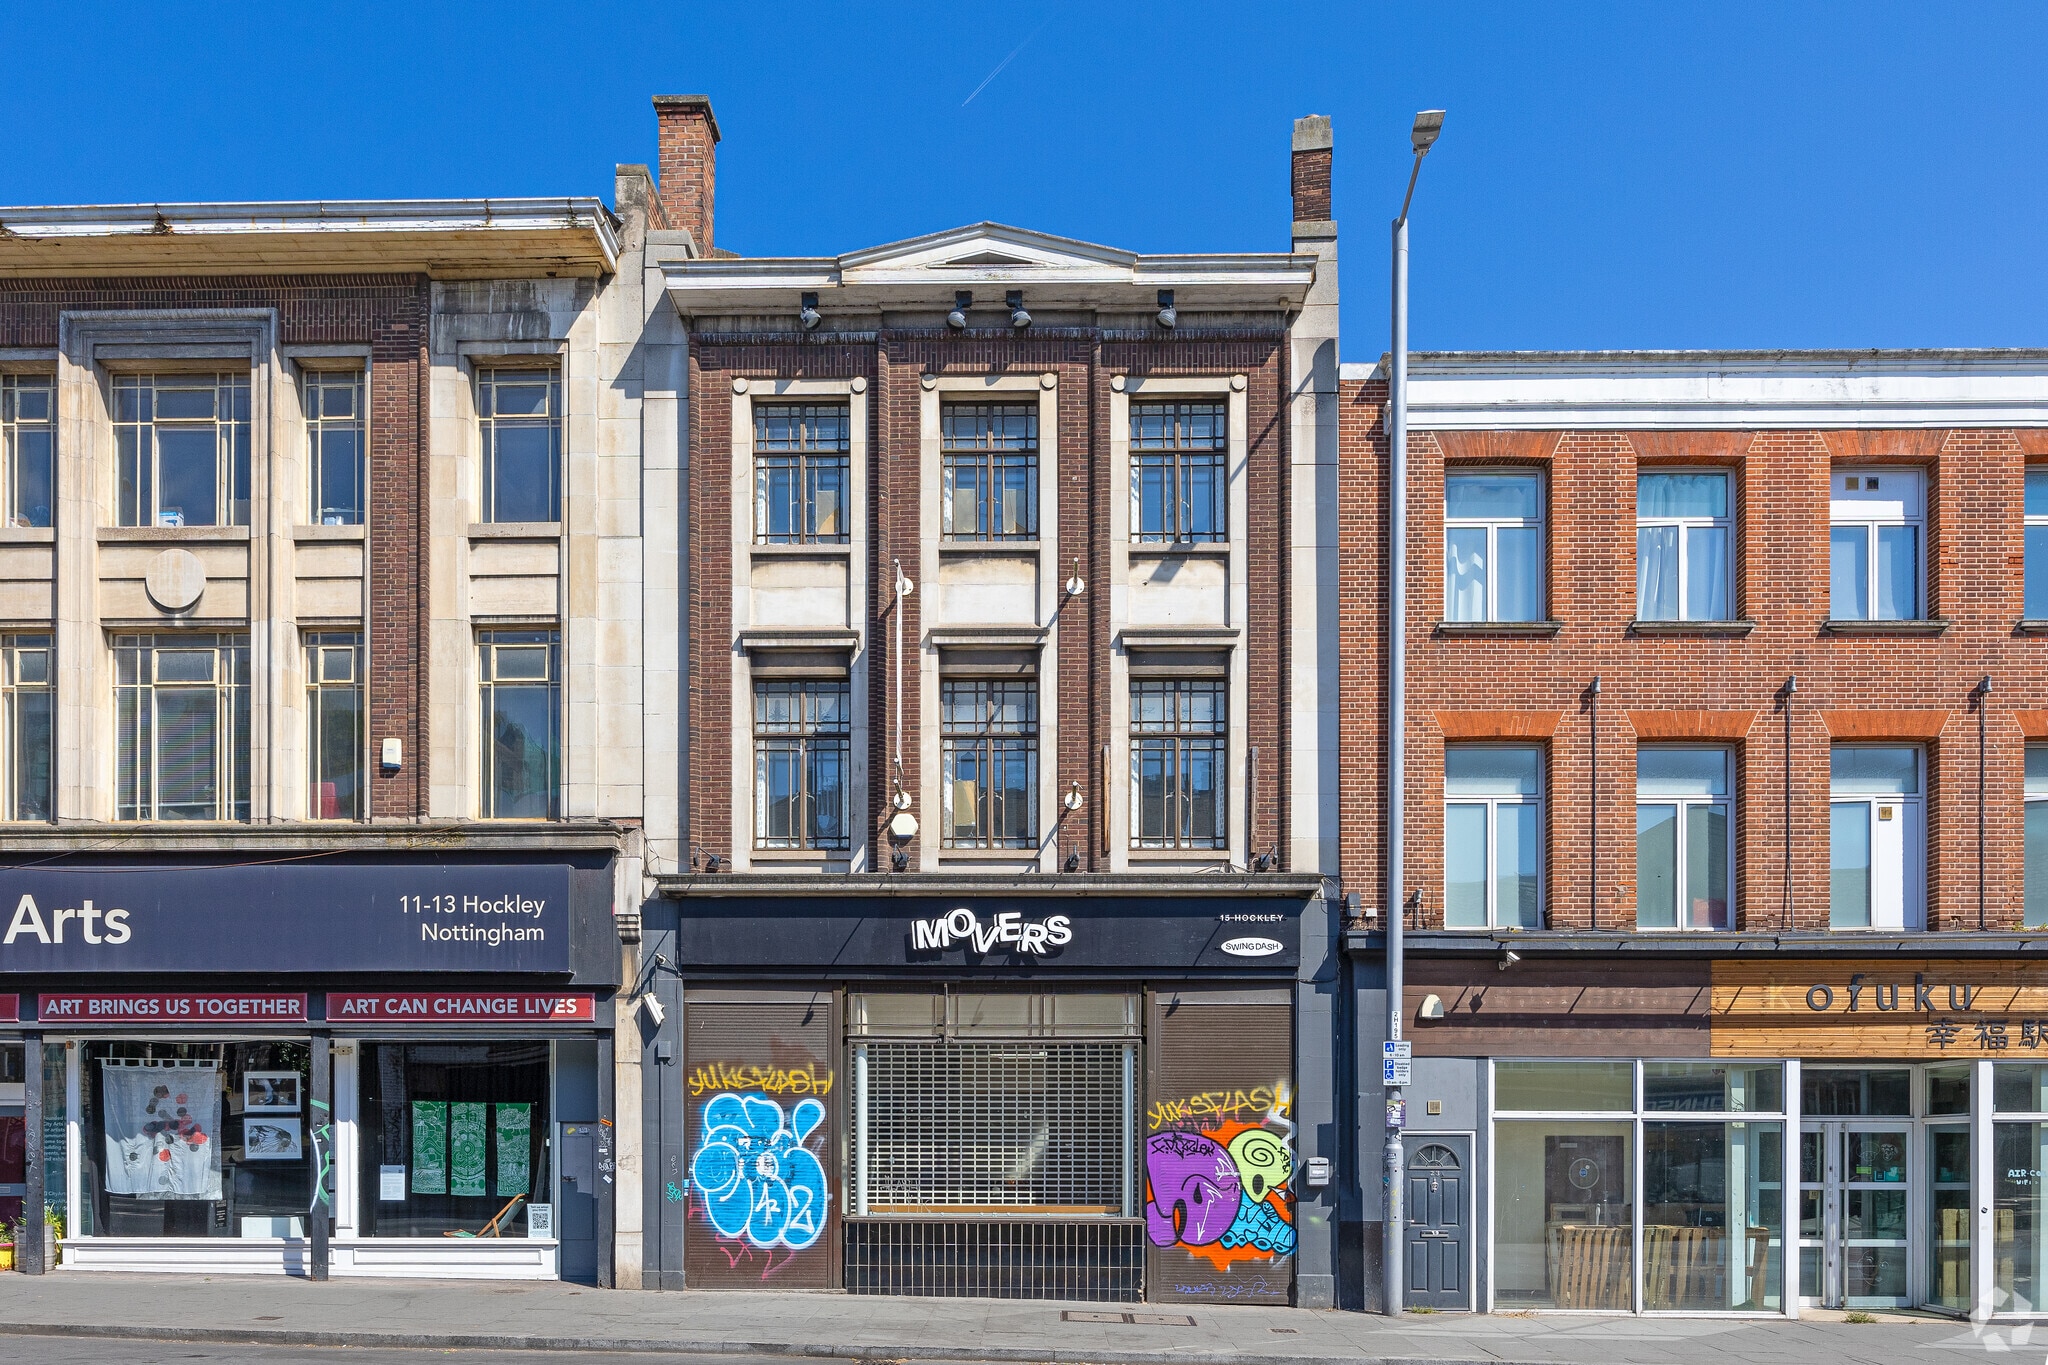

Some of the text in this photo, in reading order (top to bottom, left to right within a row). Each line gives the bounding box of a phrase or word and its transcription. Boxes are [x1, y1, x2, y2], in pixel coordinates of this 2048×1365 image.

[399, 894, 546, 919] 11-13 Hockley
[3, 894, 132, 944] Arts
[1219, 914, 1284, 922] 15 HOCKLEY
[421, 922, 545, 947] Nottingham
[910, 908, 1073, 956] MOVERS
[1225, 942, 1279, 951] SWING DASH
[45, 999, 300, 1015] ART BRINGS US TOGETHER
[341, 998, 577, 1014] ART CAN CHANGE LIVES
